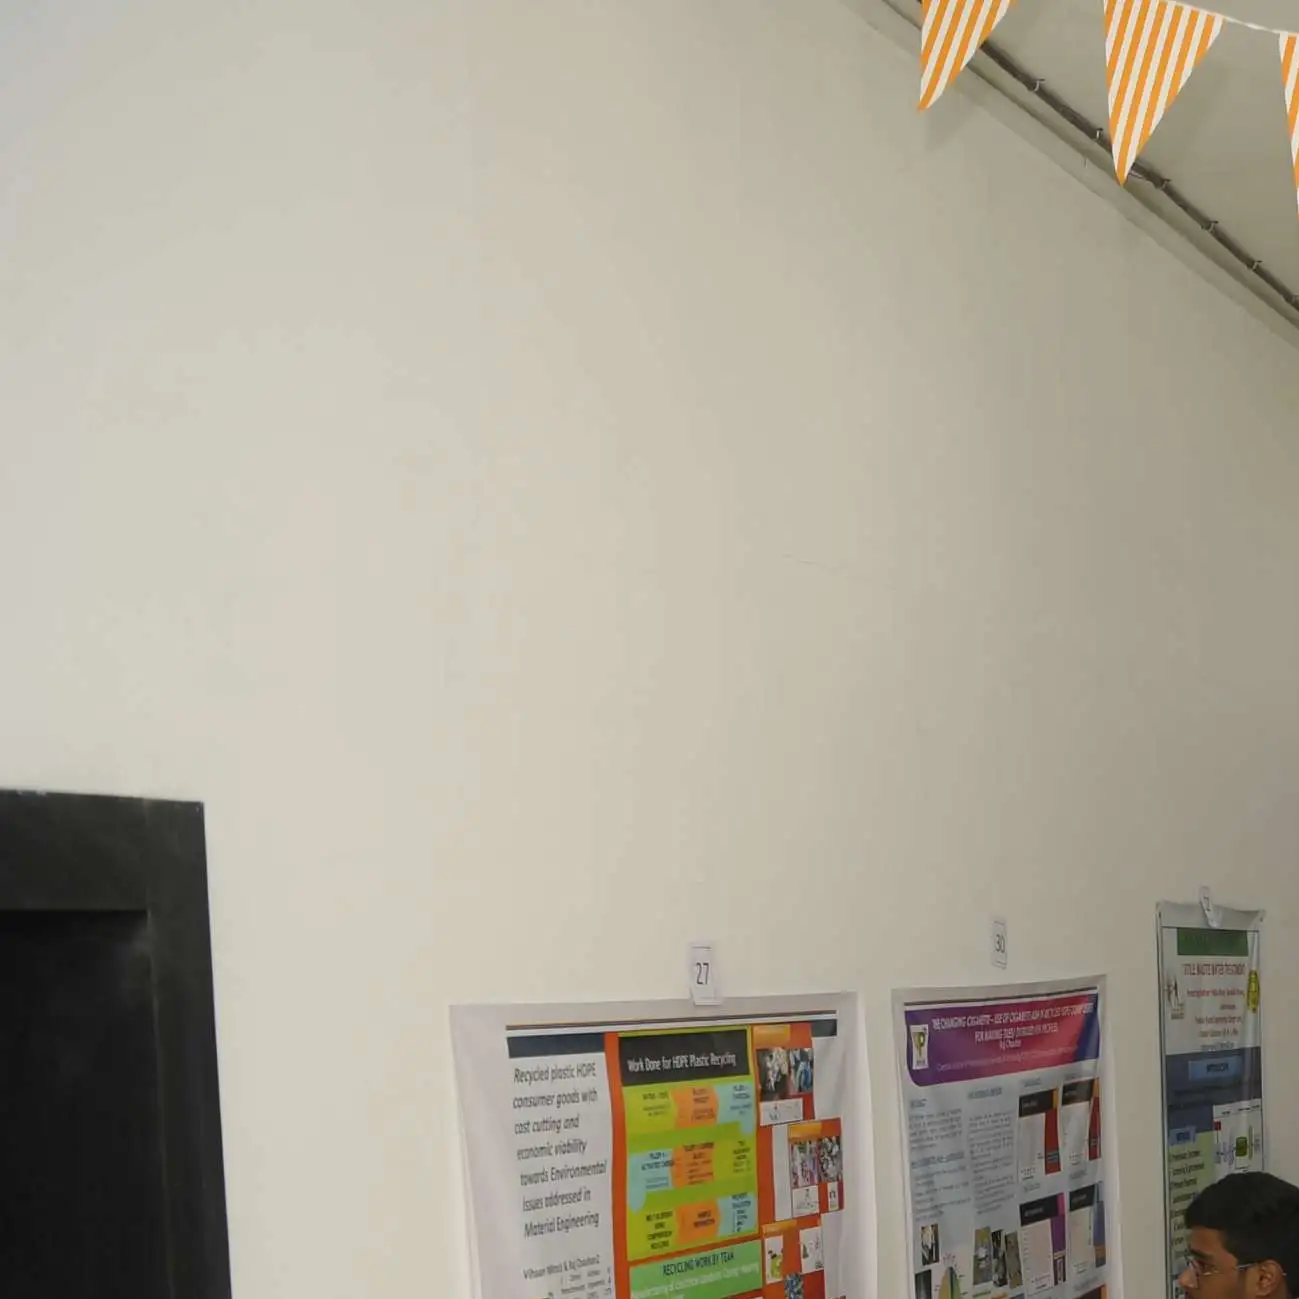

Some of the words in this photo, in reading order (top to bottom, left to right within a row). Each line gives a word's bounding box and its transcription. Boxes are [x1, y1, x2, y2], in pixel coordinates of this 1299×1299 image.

[695, 961, 711, 986] 27
[514, 1065, 549, 1087] Recycled
[551, 1064, 575, 1083] plastic
[513, 1095, 554, 1111] consumer
[556, 1089, 580, 1109] goods
[581, 1088, 598, 1104] with
[514, 1120, 531, 1135] cost
[532, 1117, 561, 1134] cutting
[563, 1114, 580, 1130] and
[517, 1144, 553, 1161] economic
[554, 1139, 587, 1158] viability
[520, 1168, 549, 1186] towards
[550, 1159, 607, 1182] Environmental
[545, 1188, 582, 1210] addressed
[583, 1187, 592, 1203] in
[524, 1218, 555, 1239] Material
[556, 1211, 600, 1234] Engineering
